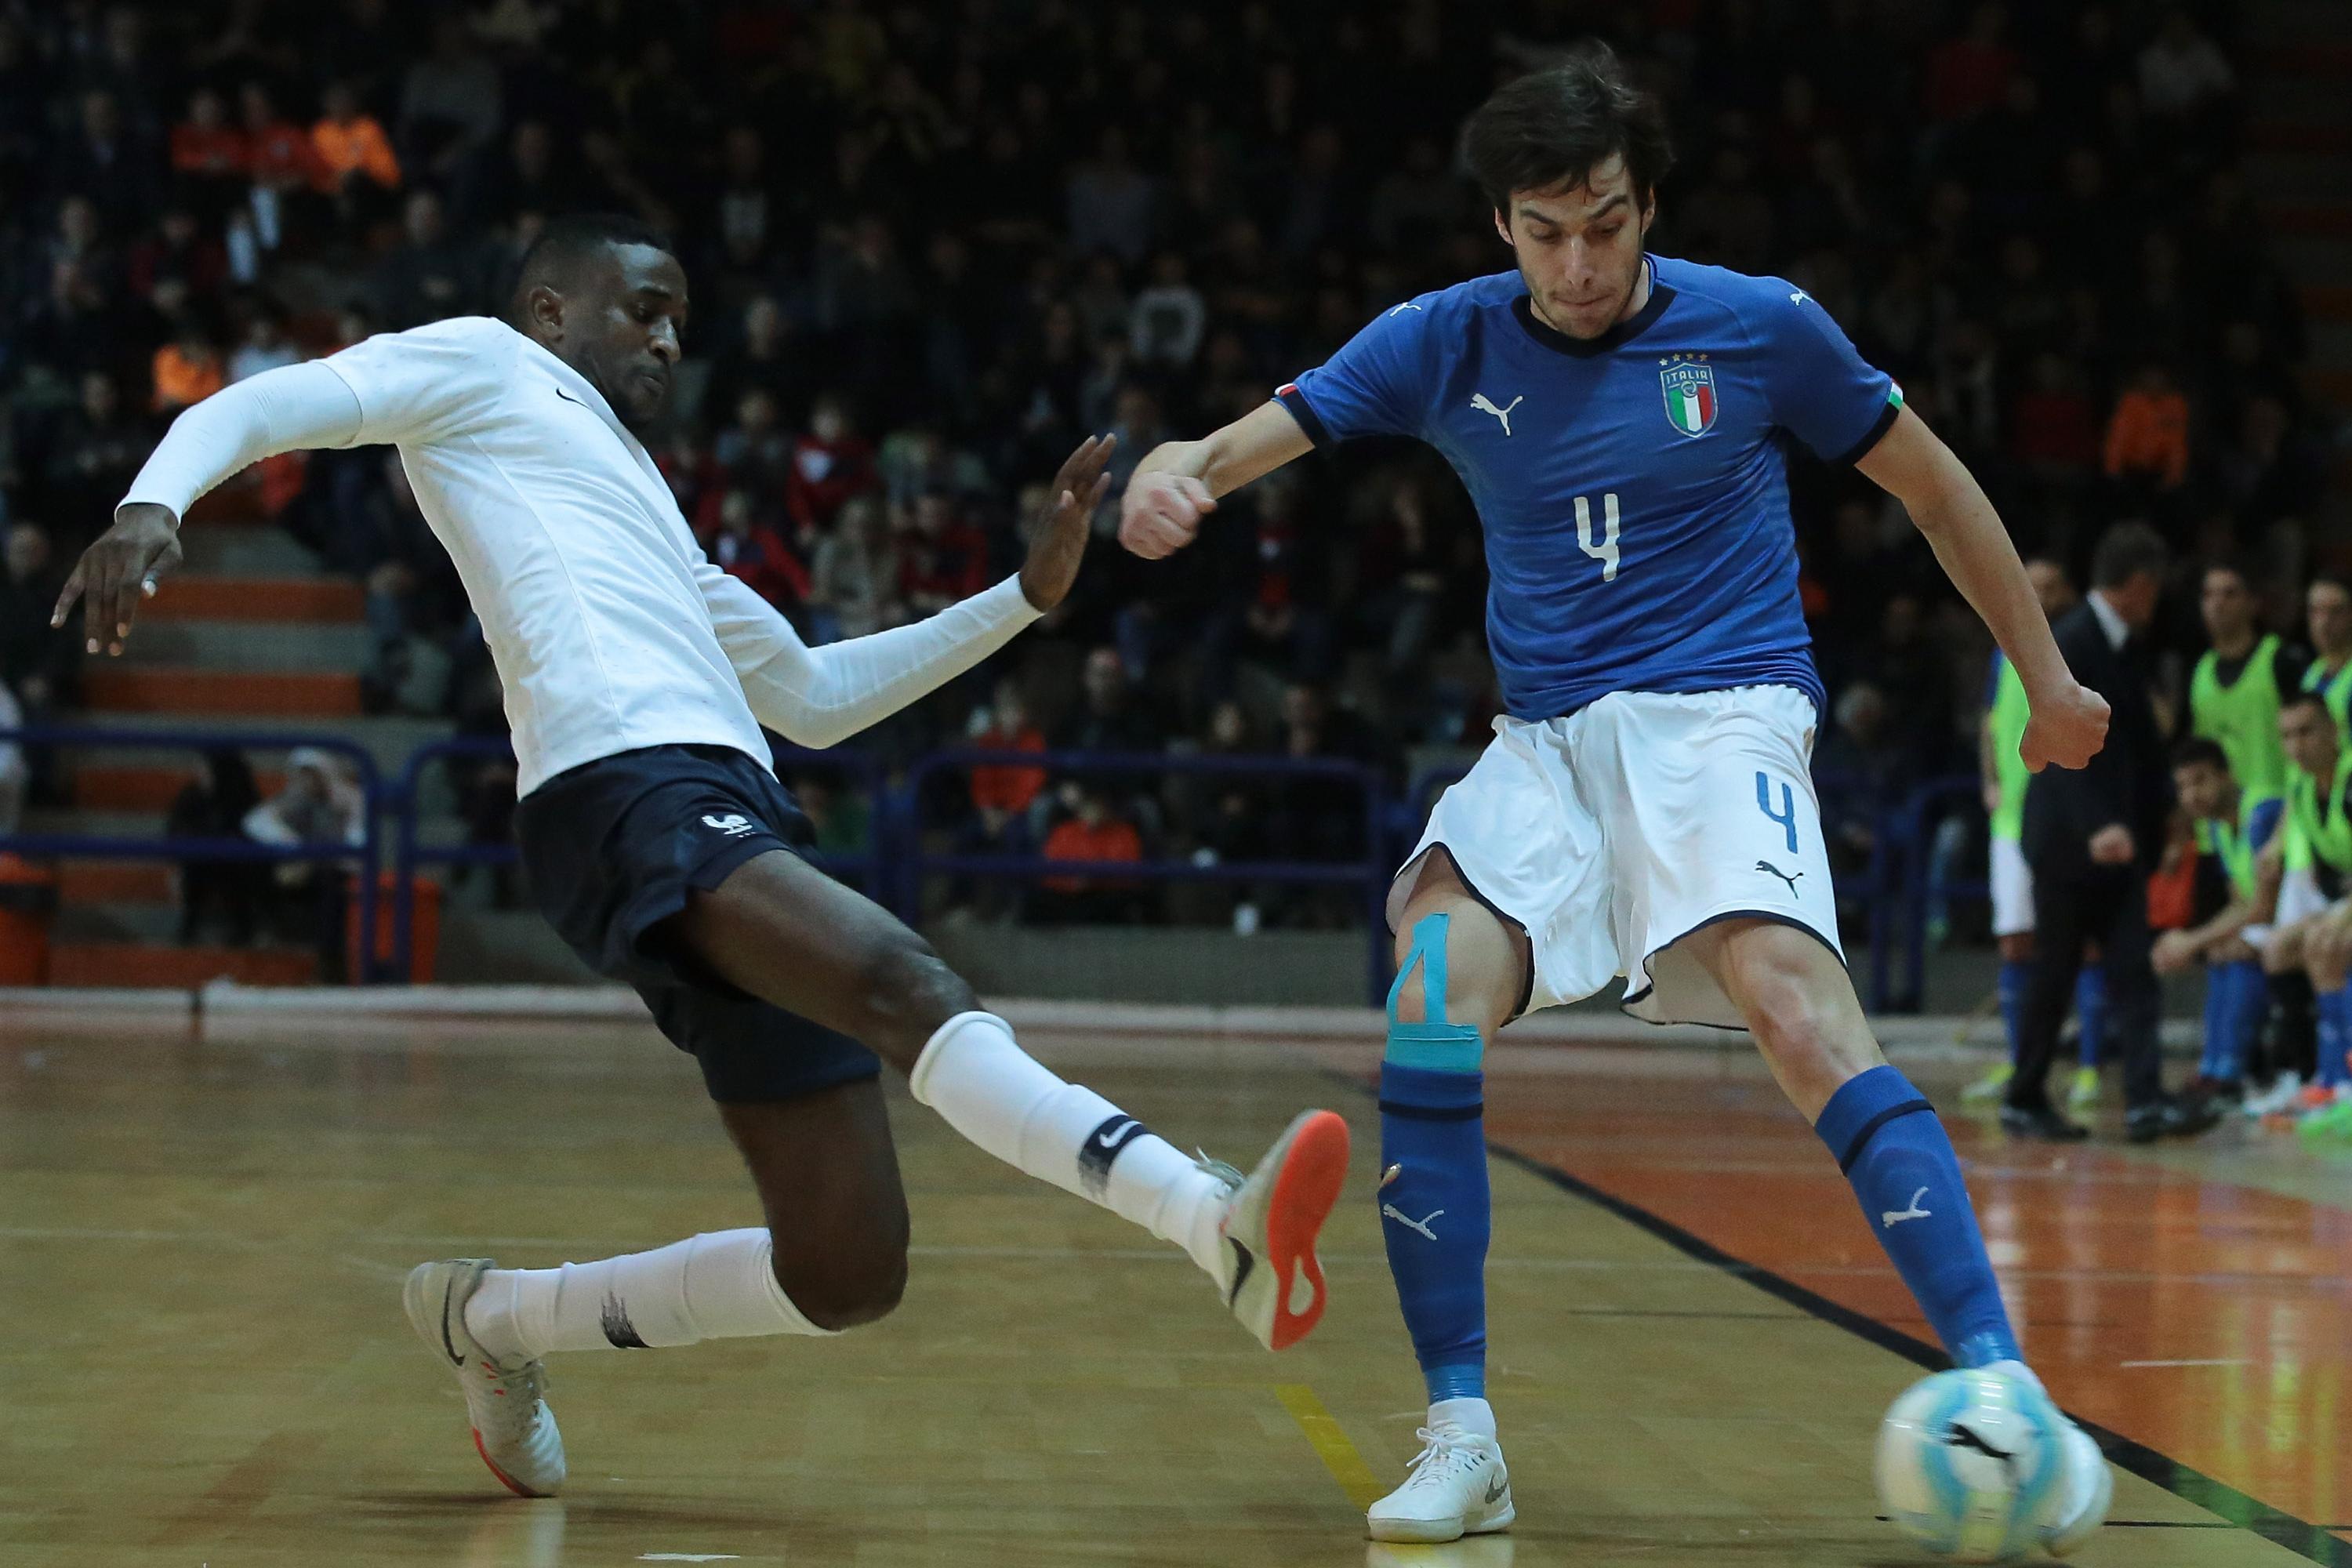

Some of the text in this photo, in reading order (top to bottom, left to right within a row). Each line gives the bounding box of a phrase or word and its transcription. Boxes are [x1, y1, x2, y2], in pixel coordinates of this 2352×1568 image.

[1666, 369, 1708, 384] ITALIA
[1573, 493, 1621, 583] 4
[1755, 771, 1798, 855] 4
